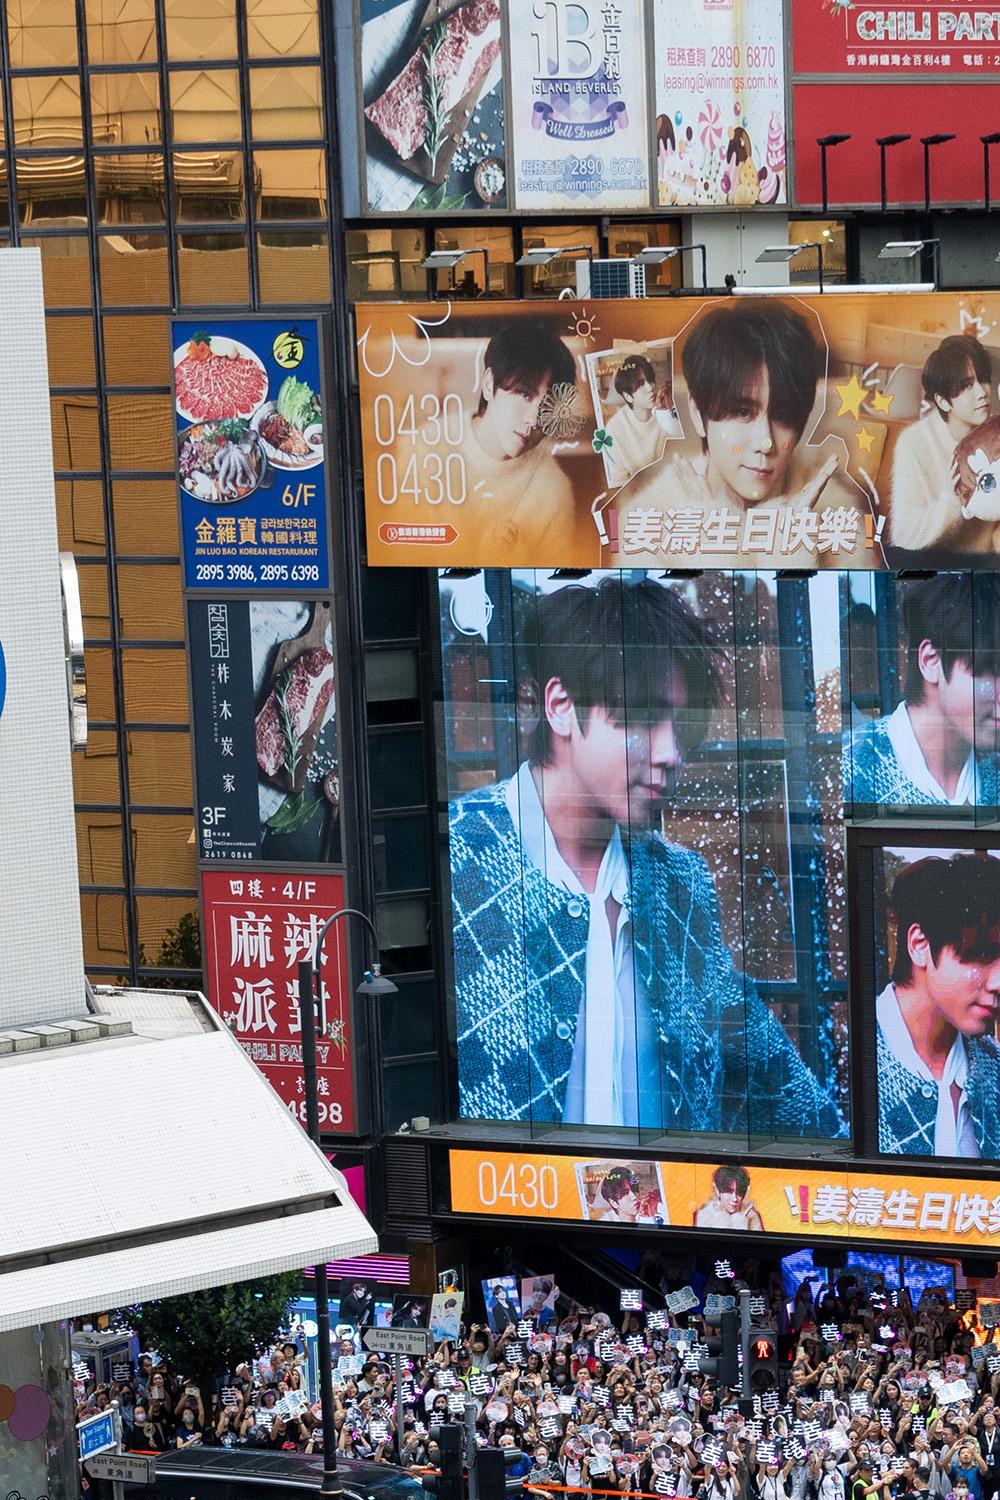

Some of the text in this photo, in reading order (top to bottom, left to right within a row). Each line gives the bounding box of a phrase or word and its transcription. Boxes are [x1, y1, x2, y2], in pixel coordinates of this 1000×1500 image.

[856, 12, 932, 41] CHILI
[667, 47, 775, 68] 租務查詢 2890 6870
[532, 81, 622, 95] ISLAND BEVERLEY
[664, 73, 779, 96] leasing@winnings.com.hk
[547, 119, 615, 139] Well Dressed
[571, 159, 603, 176] 2890
[609, 158, 643, 175] 6870
[374, 393, 464, 447] 0430
[376, 453, 467, 505] 0430
[282, 483, 317, 508] 6/F
[195, 517, 258, 545] 金羅寶
[261, 518, 317, 529] 금라보한국요리
[261, 531, 317, 545] 韓國料理
[239, 548, 268, 556] KOREAN
[196, 564, 319, 583] 2895 3986, 2895 6398
[217, 662, 235, 794] 柞木炭家
[202, 806, 226, 825] 3F
[205, 850, 253, 860] 2619 0868
[229, 879, 316, 900] 四樓 4/F
[478, 1161, 558, 1209] 0430
[389, 1342, 412, 1351] 東角道
[129, 1461, 147, 1469] Road
